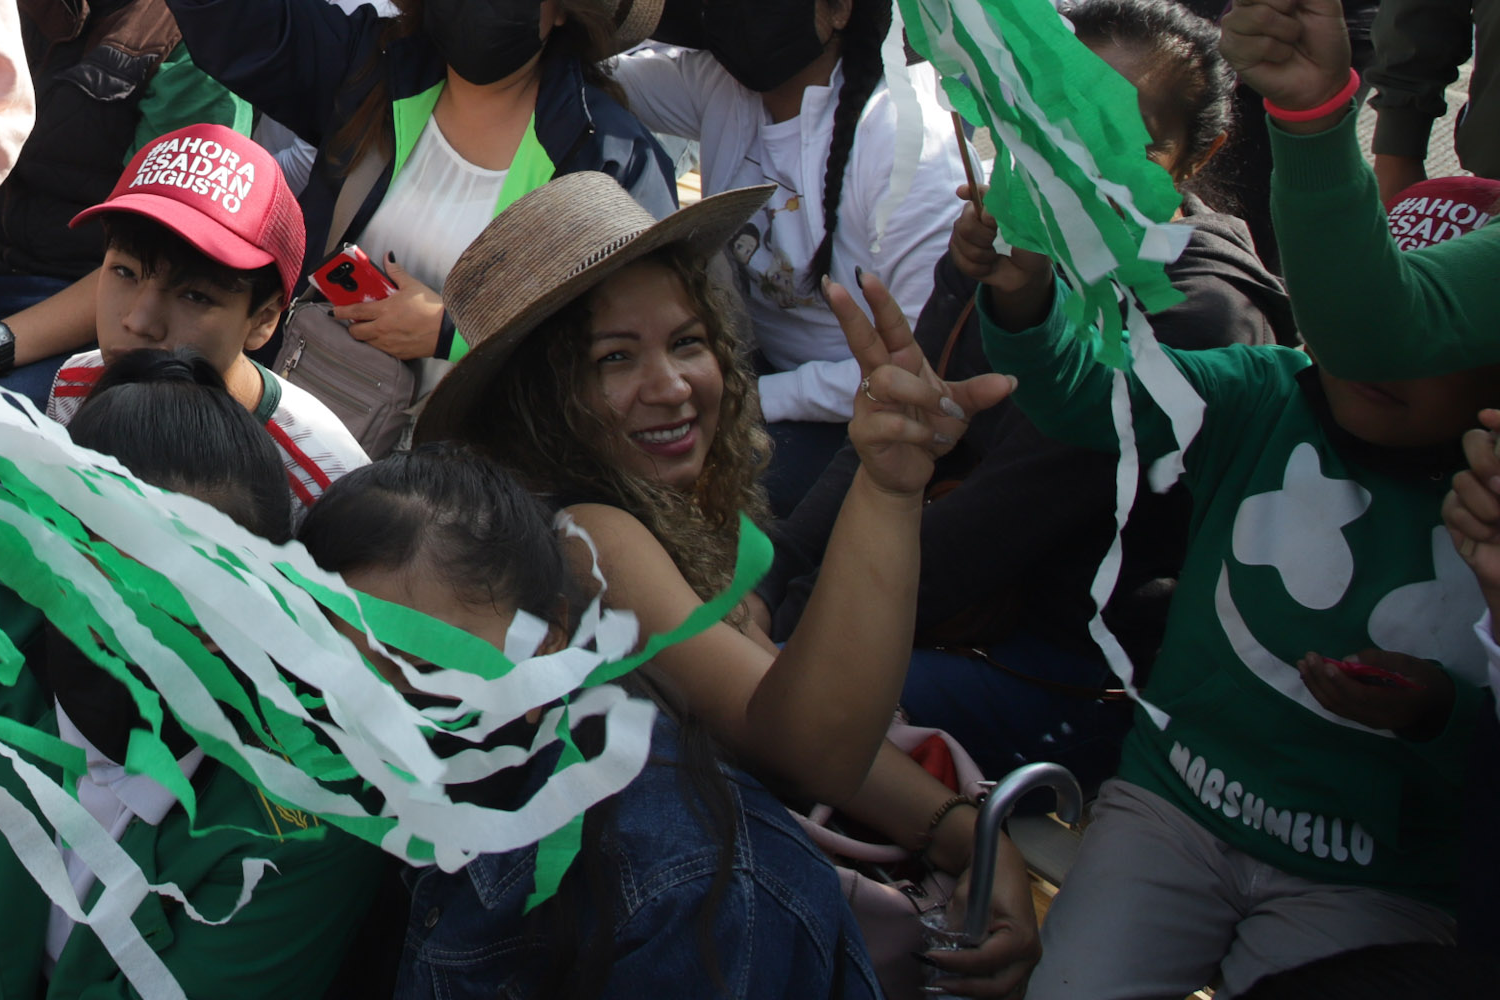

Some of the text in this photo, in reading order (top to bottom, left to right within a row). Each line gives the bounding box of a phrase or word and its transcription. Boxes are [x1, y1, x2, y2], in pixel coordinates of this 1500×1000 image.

[147, 137, 255, 183] #AHORA
[129, 170, 242, 214] AUGUSTO
[1168, 740, 1374, 866] MARSHMELLO
